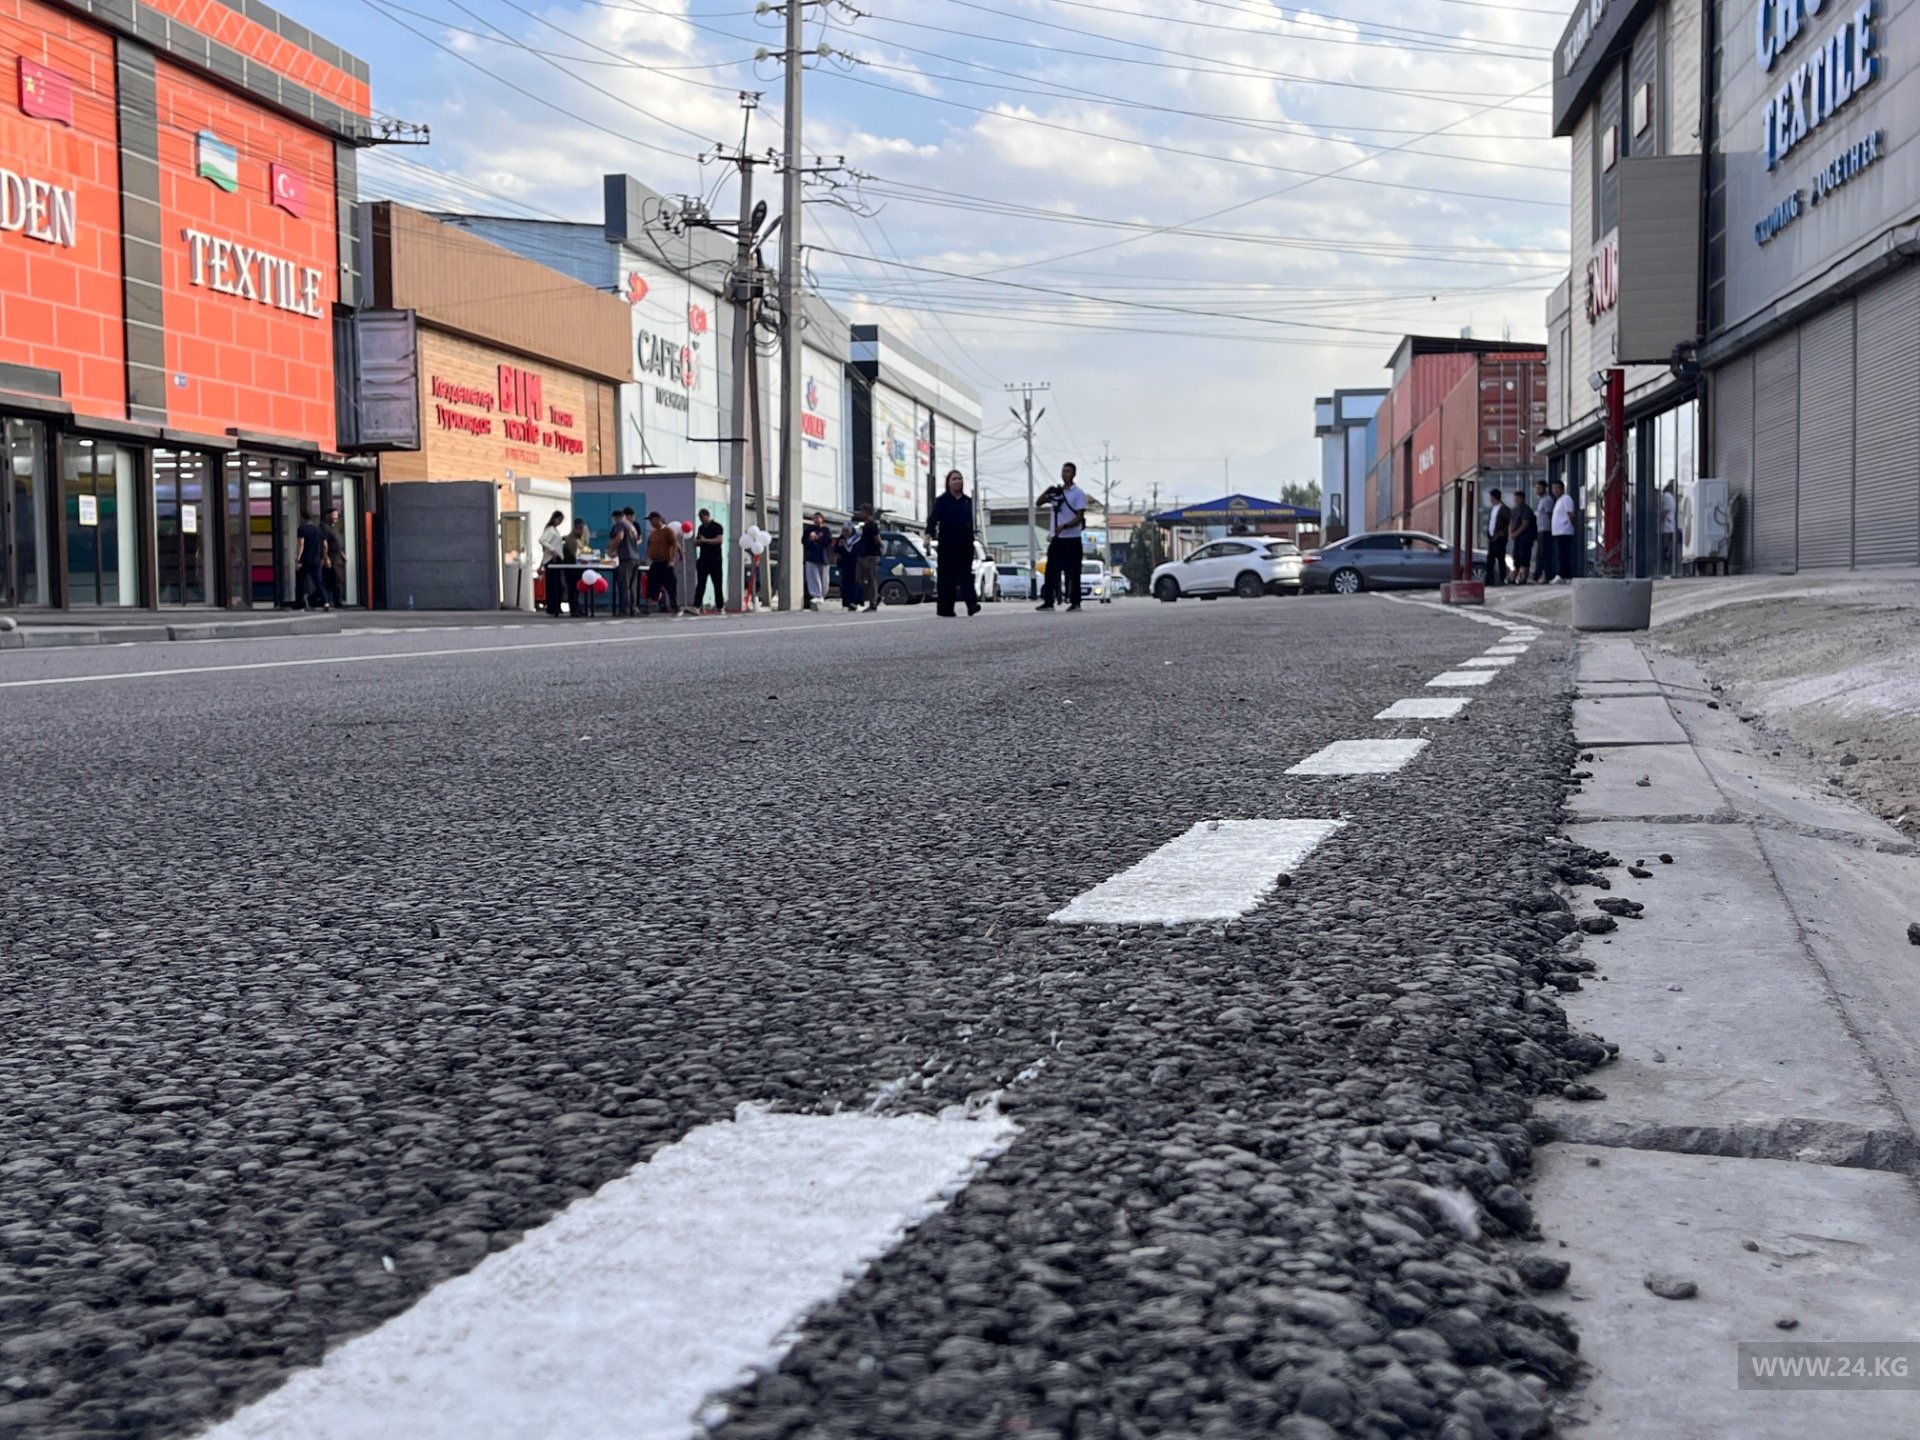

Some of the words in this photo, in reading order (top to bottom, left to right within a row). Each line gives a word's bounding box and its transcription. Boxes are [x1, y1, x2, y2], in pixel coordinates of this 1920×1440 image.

[1762, 0, 1879, 172] TEXTILE
[182, 228, 324, 319] TEXTILE
[498, 364, 543, 421] BIM
